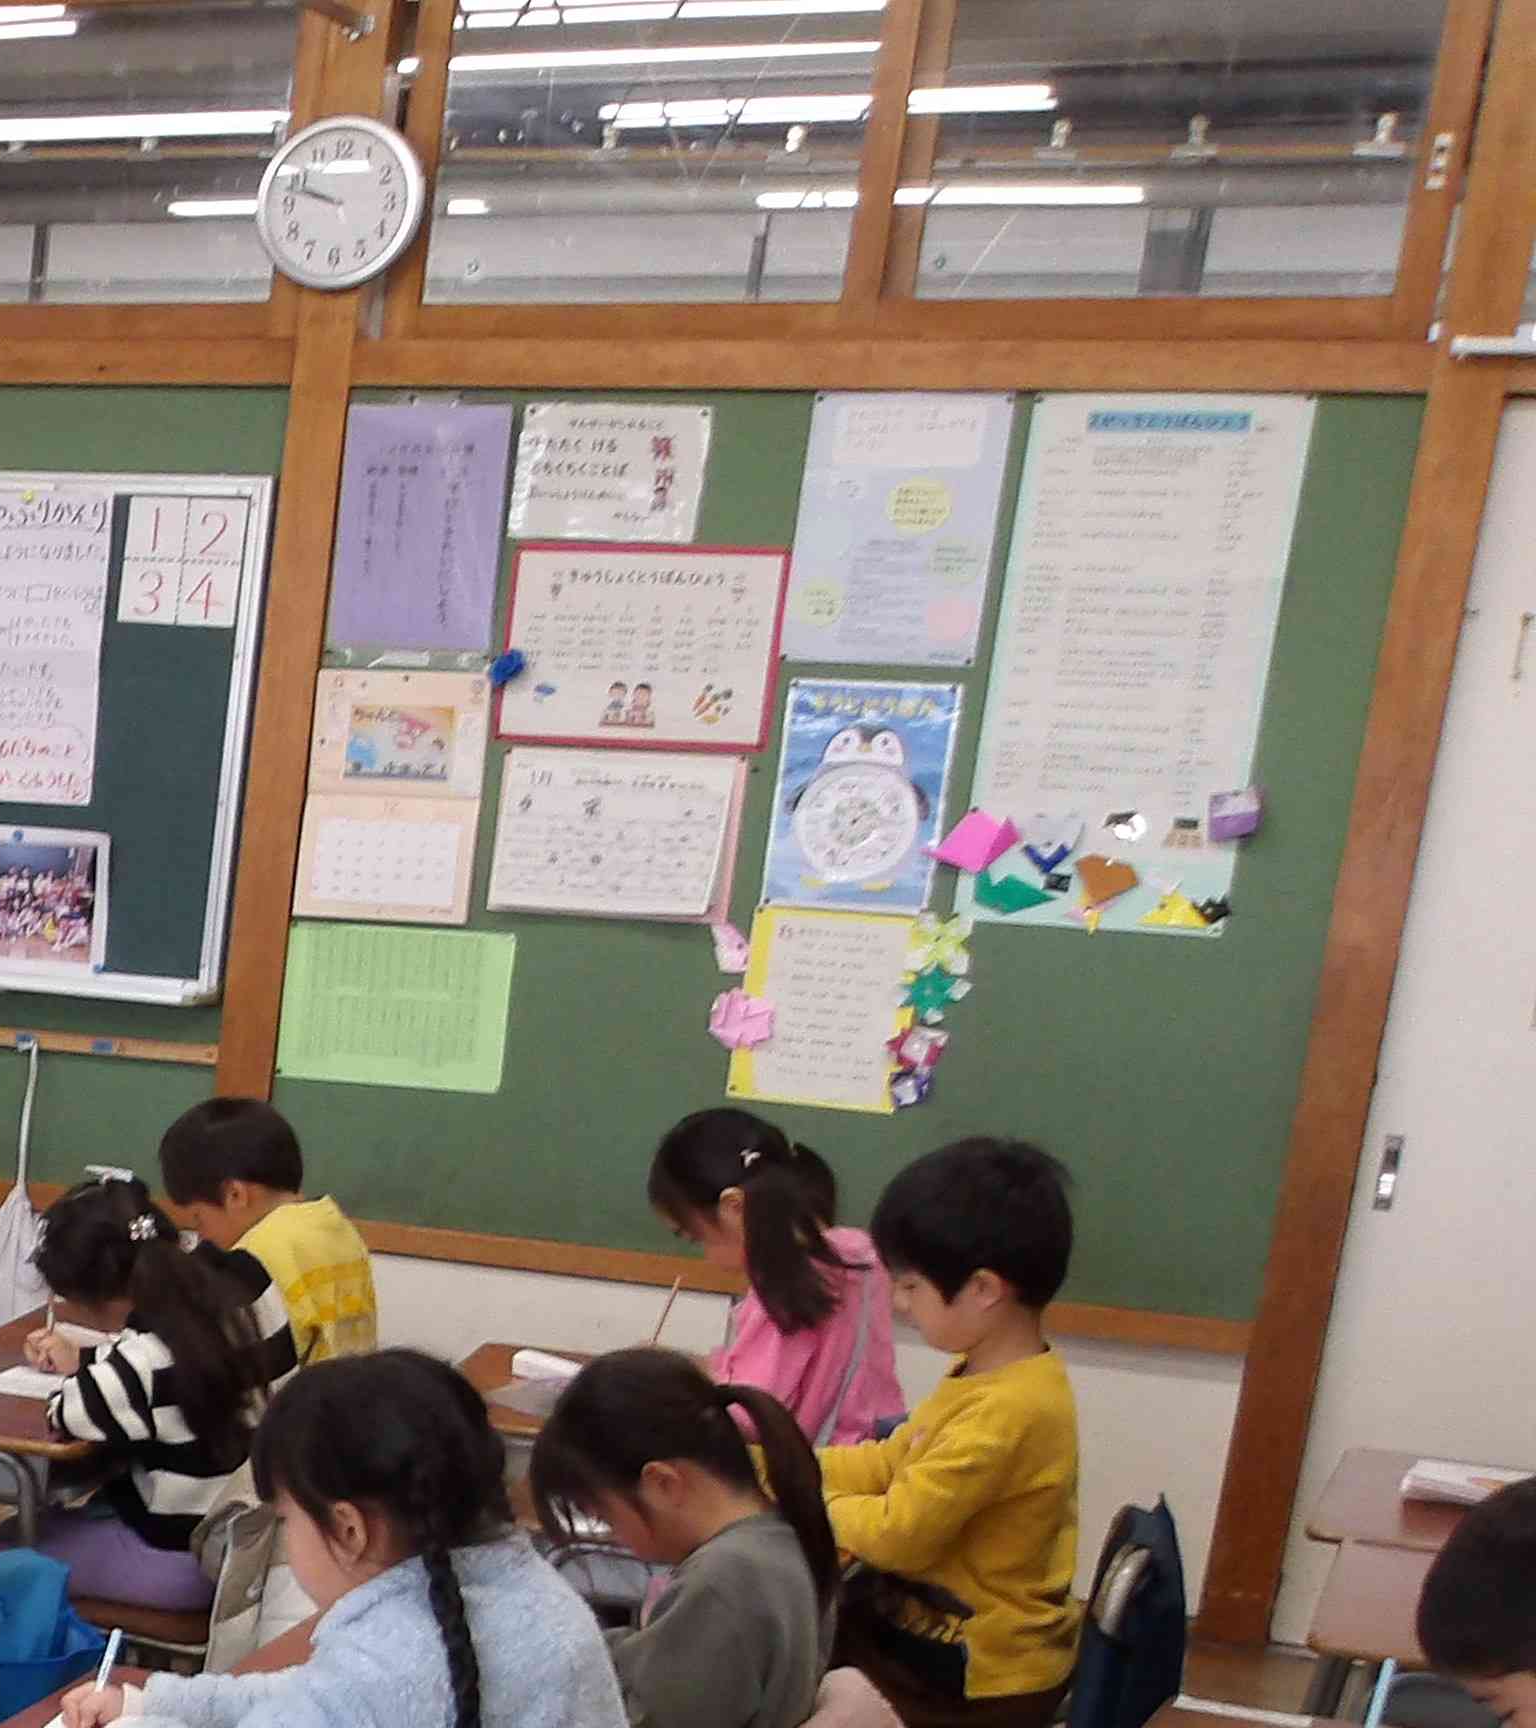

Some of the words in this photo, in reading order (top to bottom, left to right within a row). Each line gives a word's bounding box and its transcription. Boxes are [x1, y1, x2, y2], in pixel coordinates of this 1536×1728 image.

[334, 138, 354, 158] 12
[366, 145, 374, 159] 1
[379, 164, 392, 185] 2
[282, 195, 296, 215] 9
[383, 190, 397, 212] 3
[284, 220, 300, 242] 8
[303, 239, 317, 261] 7
[352, 238, 367, 259] 5
[151, 507, 161, 553] 1
[198, 511, 228, 556] 2
[132, 570, 164, 616] 3
[185, 571, 226, 620] 4
